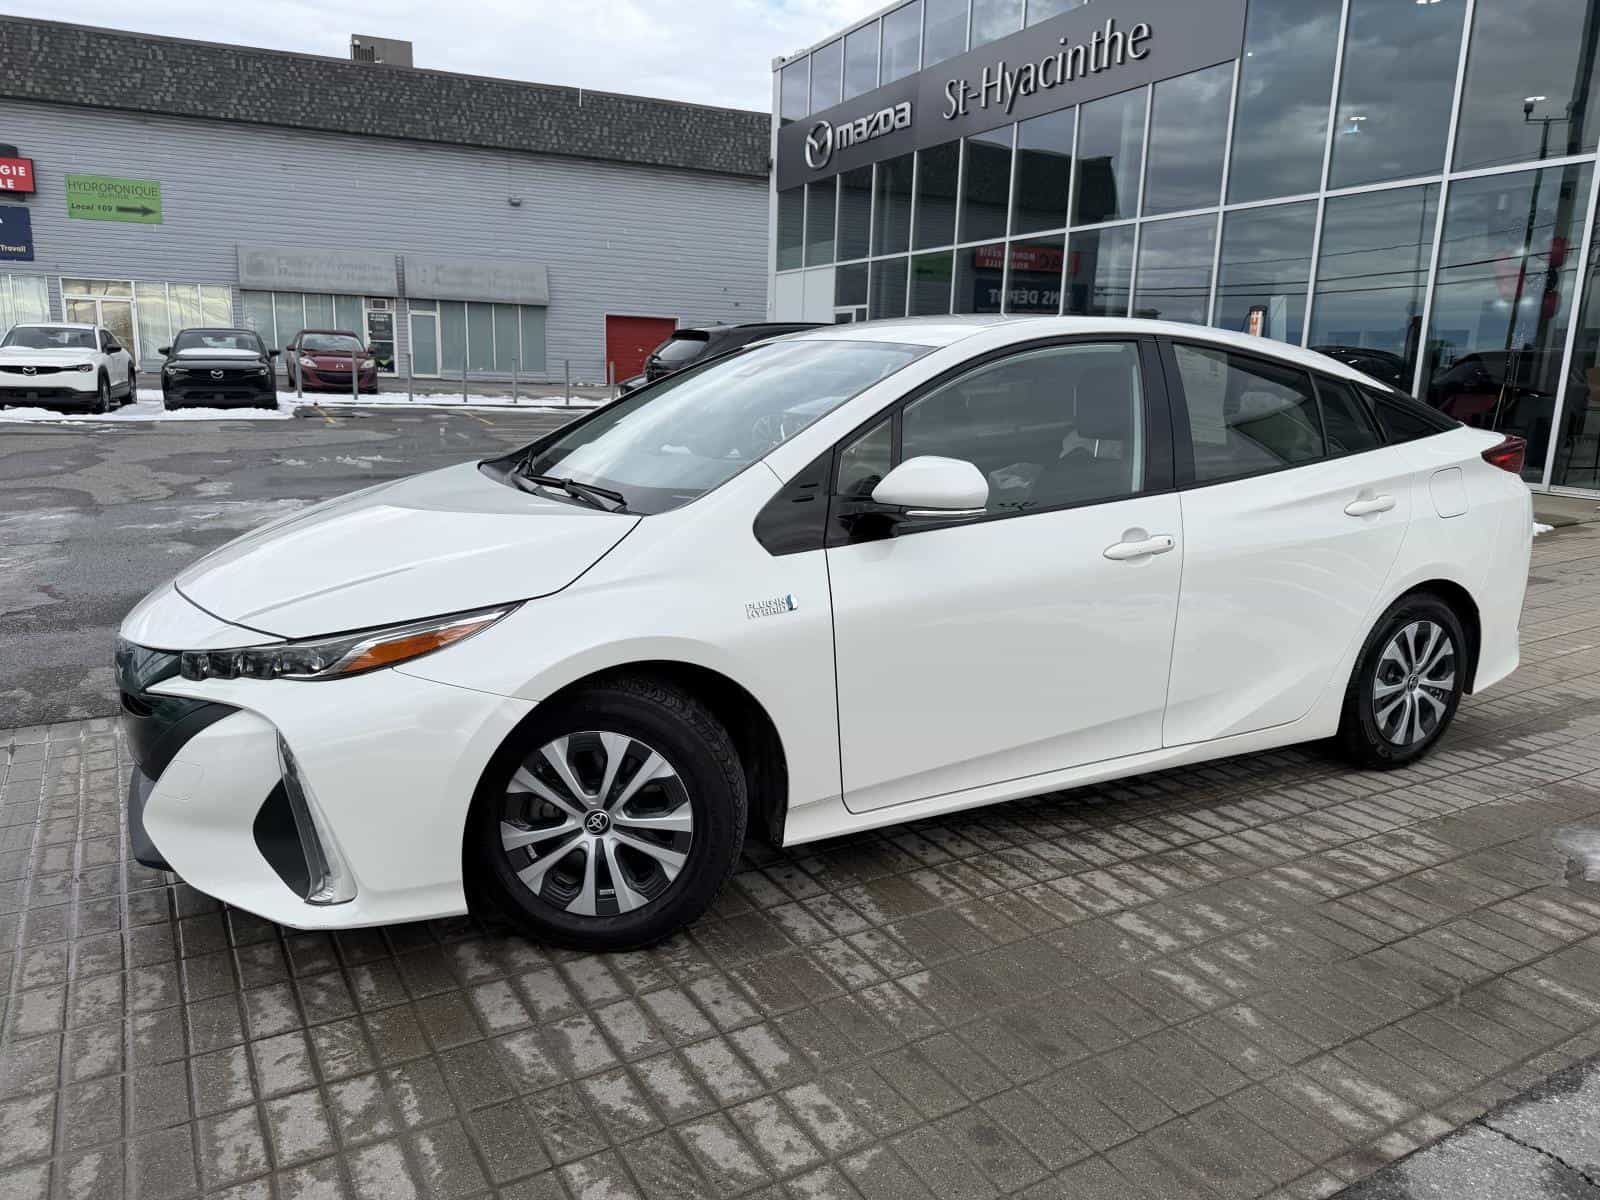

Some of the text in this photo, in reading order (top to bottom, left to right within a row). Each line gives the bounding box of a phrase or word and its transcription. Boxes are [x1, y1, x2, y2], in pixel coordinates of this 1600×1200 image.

[943, 18, 1151, 120] St-Hyacinthe
[836, 101, 912, 150] mazda
[67, 181, 159, 197] HYDROPONIQUE
[71, 203, 113, 212] Local 109
